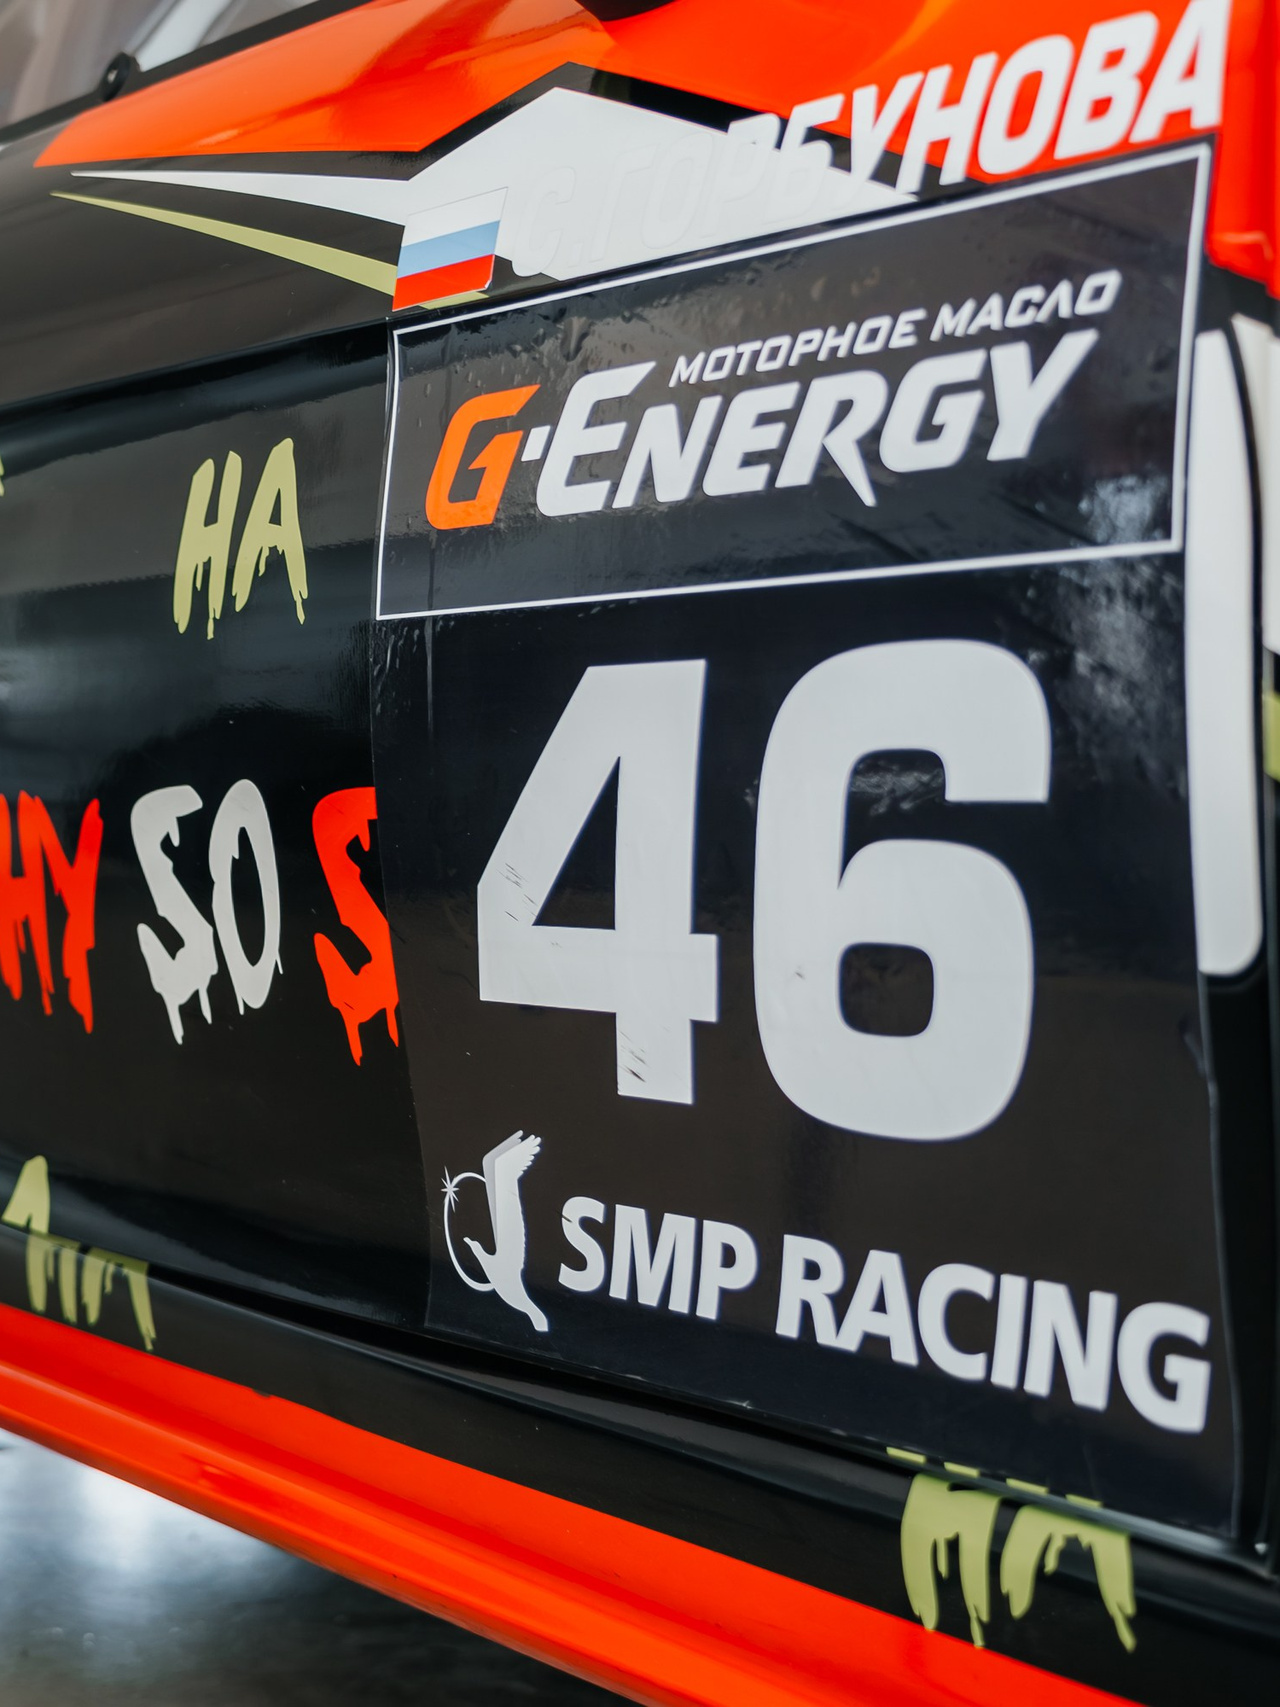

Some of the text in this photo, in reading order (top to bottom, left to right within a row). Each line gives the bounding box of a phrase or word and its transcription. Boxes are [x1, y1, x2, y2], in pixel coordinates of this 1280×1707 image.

[668, 270, 1121, 388] МОТОРНОЕ МАСЛО
[173, 437, 308, 640] HA
[131, 779, 283, 1045] SO
[477, 638, 1052, 1142] 46
[558, 1196, 1211, 1433] SMP RACING
